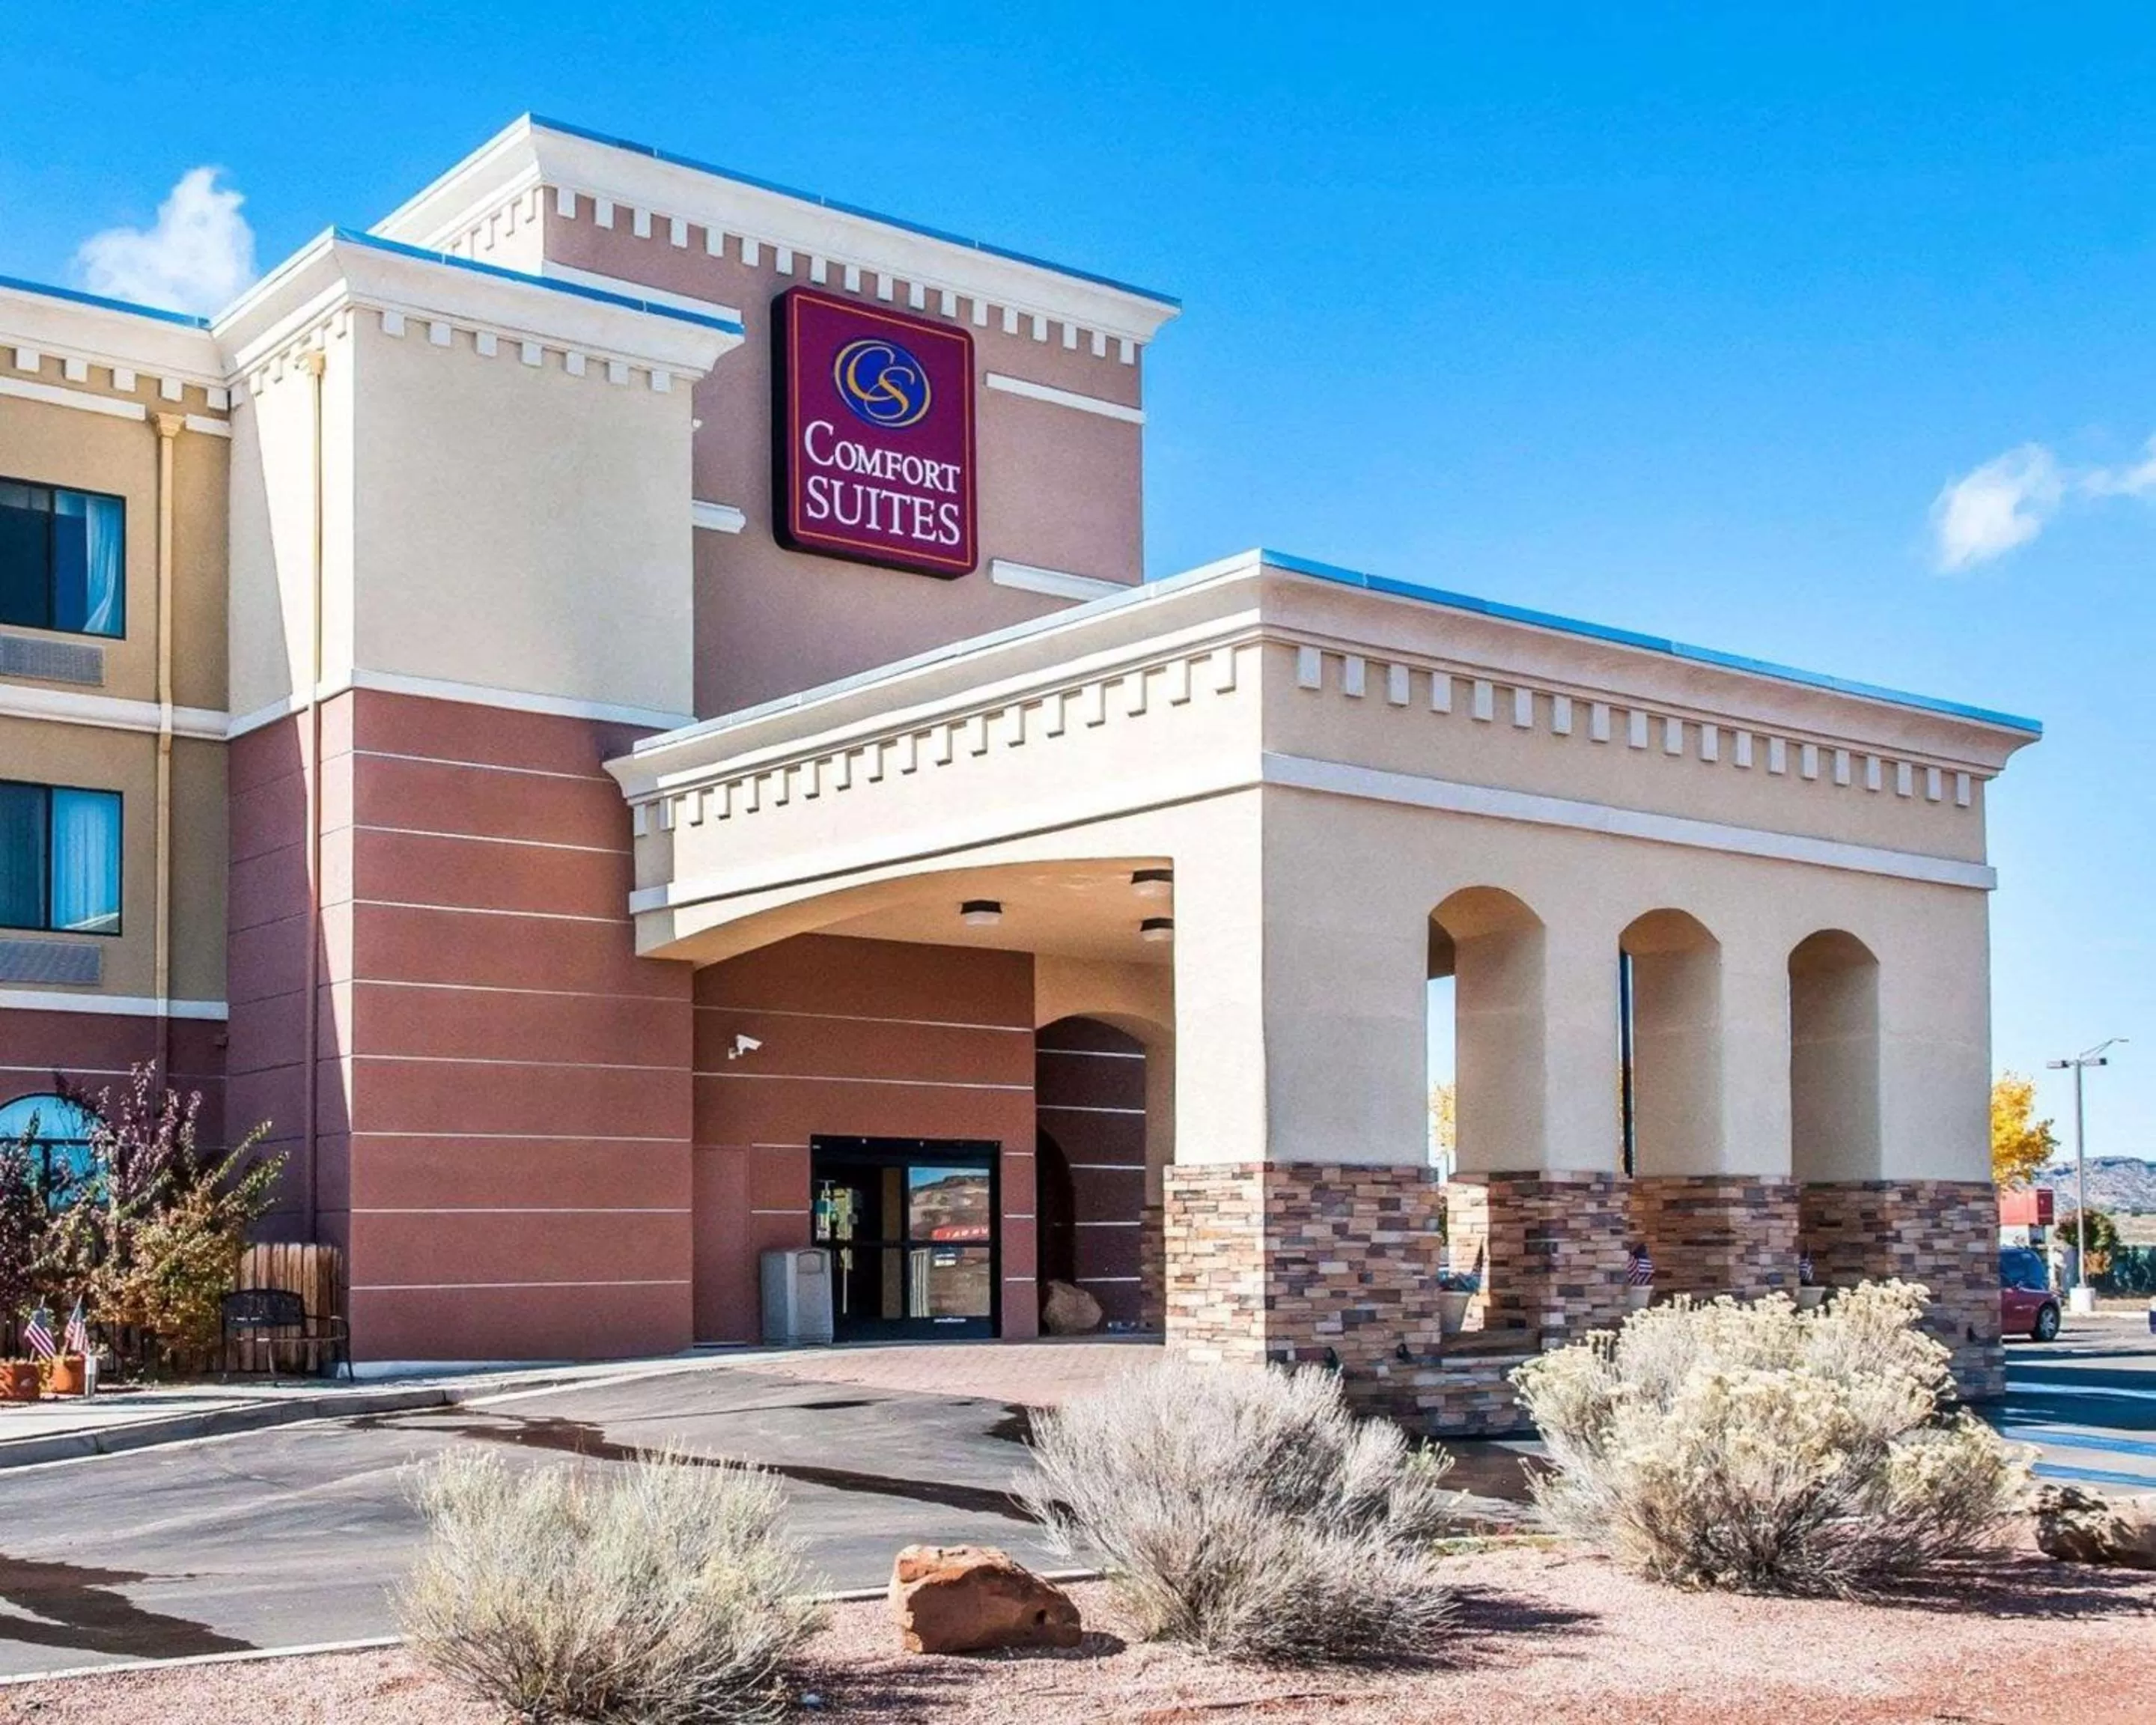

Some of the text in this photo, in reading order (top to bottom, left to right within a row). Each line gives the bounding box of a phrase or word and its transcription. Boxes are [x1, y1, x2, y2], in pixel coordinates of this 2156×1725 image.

[846, 345, 915, 420] CS
[803, 420, 961, 494] COMFORT
[805, 475, 961, 546] SUITES
